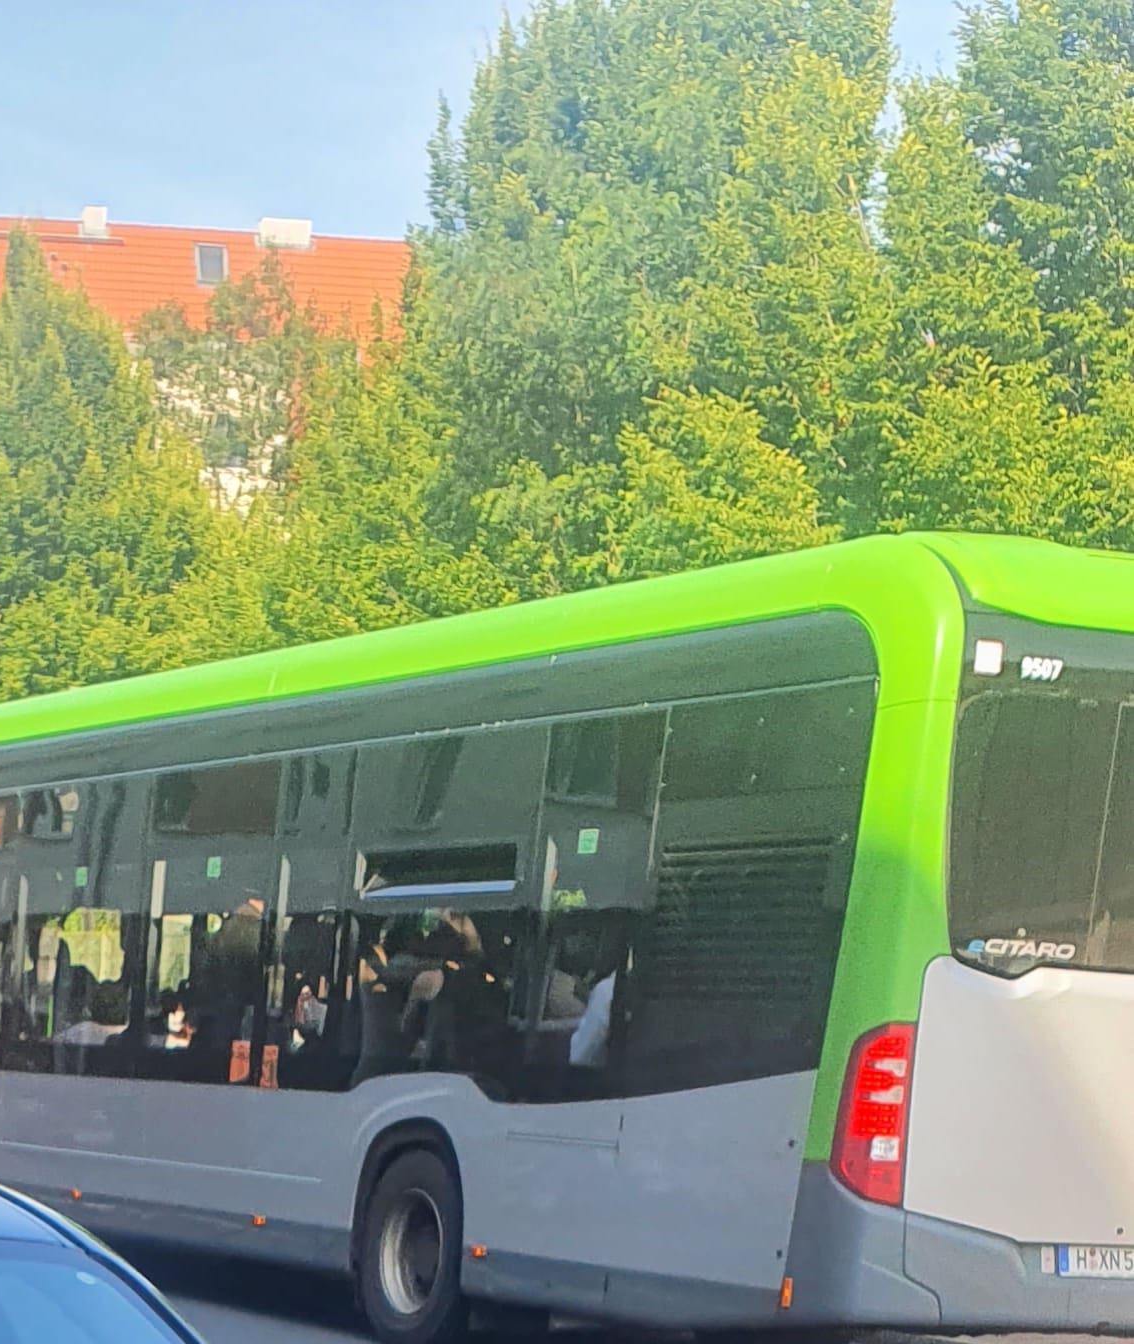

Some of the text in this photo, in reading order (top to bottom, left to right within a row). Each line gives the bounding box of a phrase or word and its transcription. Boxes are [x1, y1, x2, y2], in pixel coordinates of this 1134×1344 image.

[1021, 655, 1064, 682] 9507
[968, 938, 1076, 960] eCITARO
[1077, 1247, 1087, 1270] H
[1099, 1247, 1121, 1271] XN
